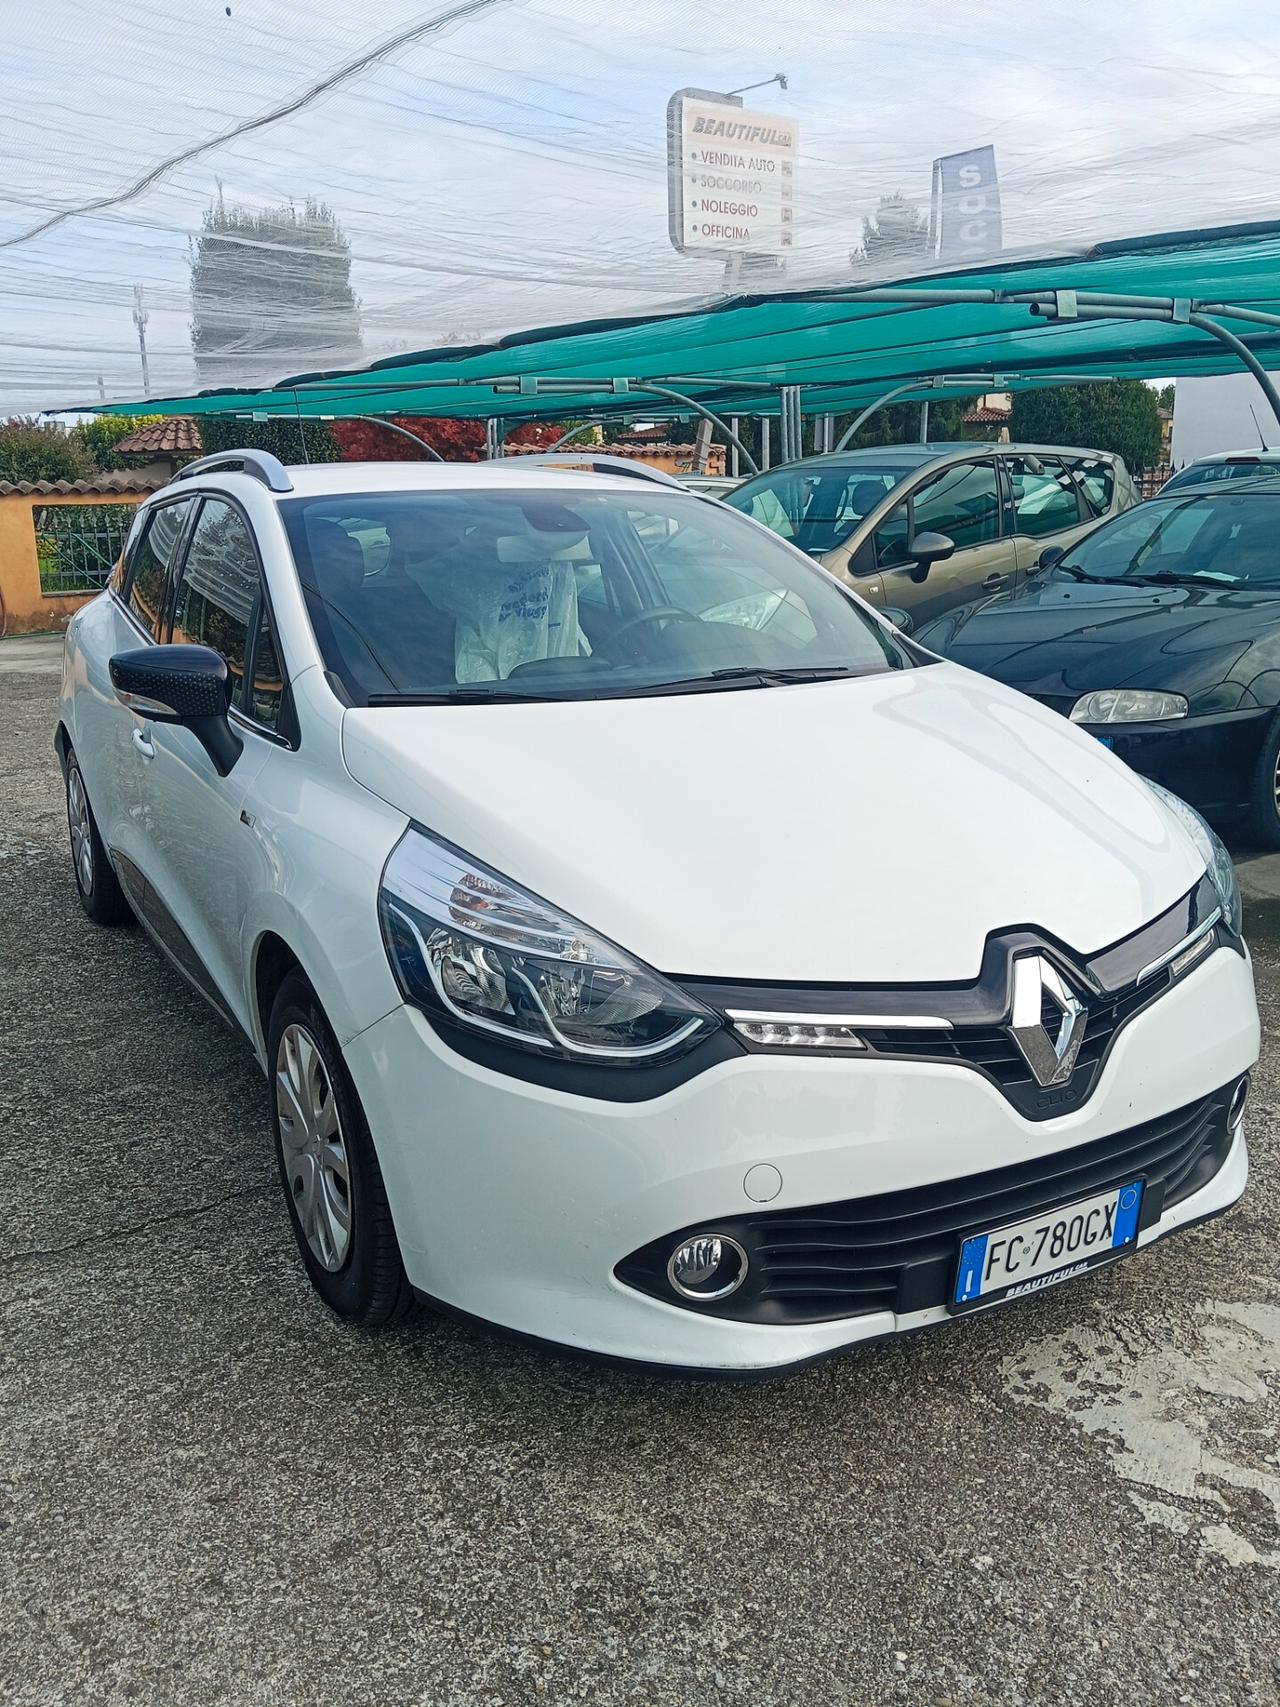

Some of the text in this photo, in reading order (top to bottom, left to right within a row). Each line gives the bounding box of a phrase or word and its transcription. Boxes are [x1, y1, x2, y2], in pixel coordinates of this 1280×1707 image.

[692, 117, 779, 146] BEAUTIFUL
[701, 150, 776, 173] VENDITA AUTO
[701, 175, 762, 194] SOCCORSO
[701, 199, 758, 217] NOLEGGIO
[959, 164, 987, 257] SOC
[701, 223, 750, 240] OFFICINA
[1037, 1089, 1077, 1110] CLIO
